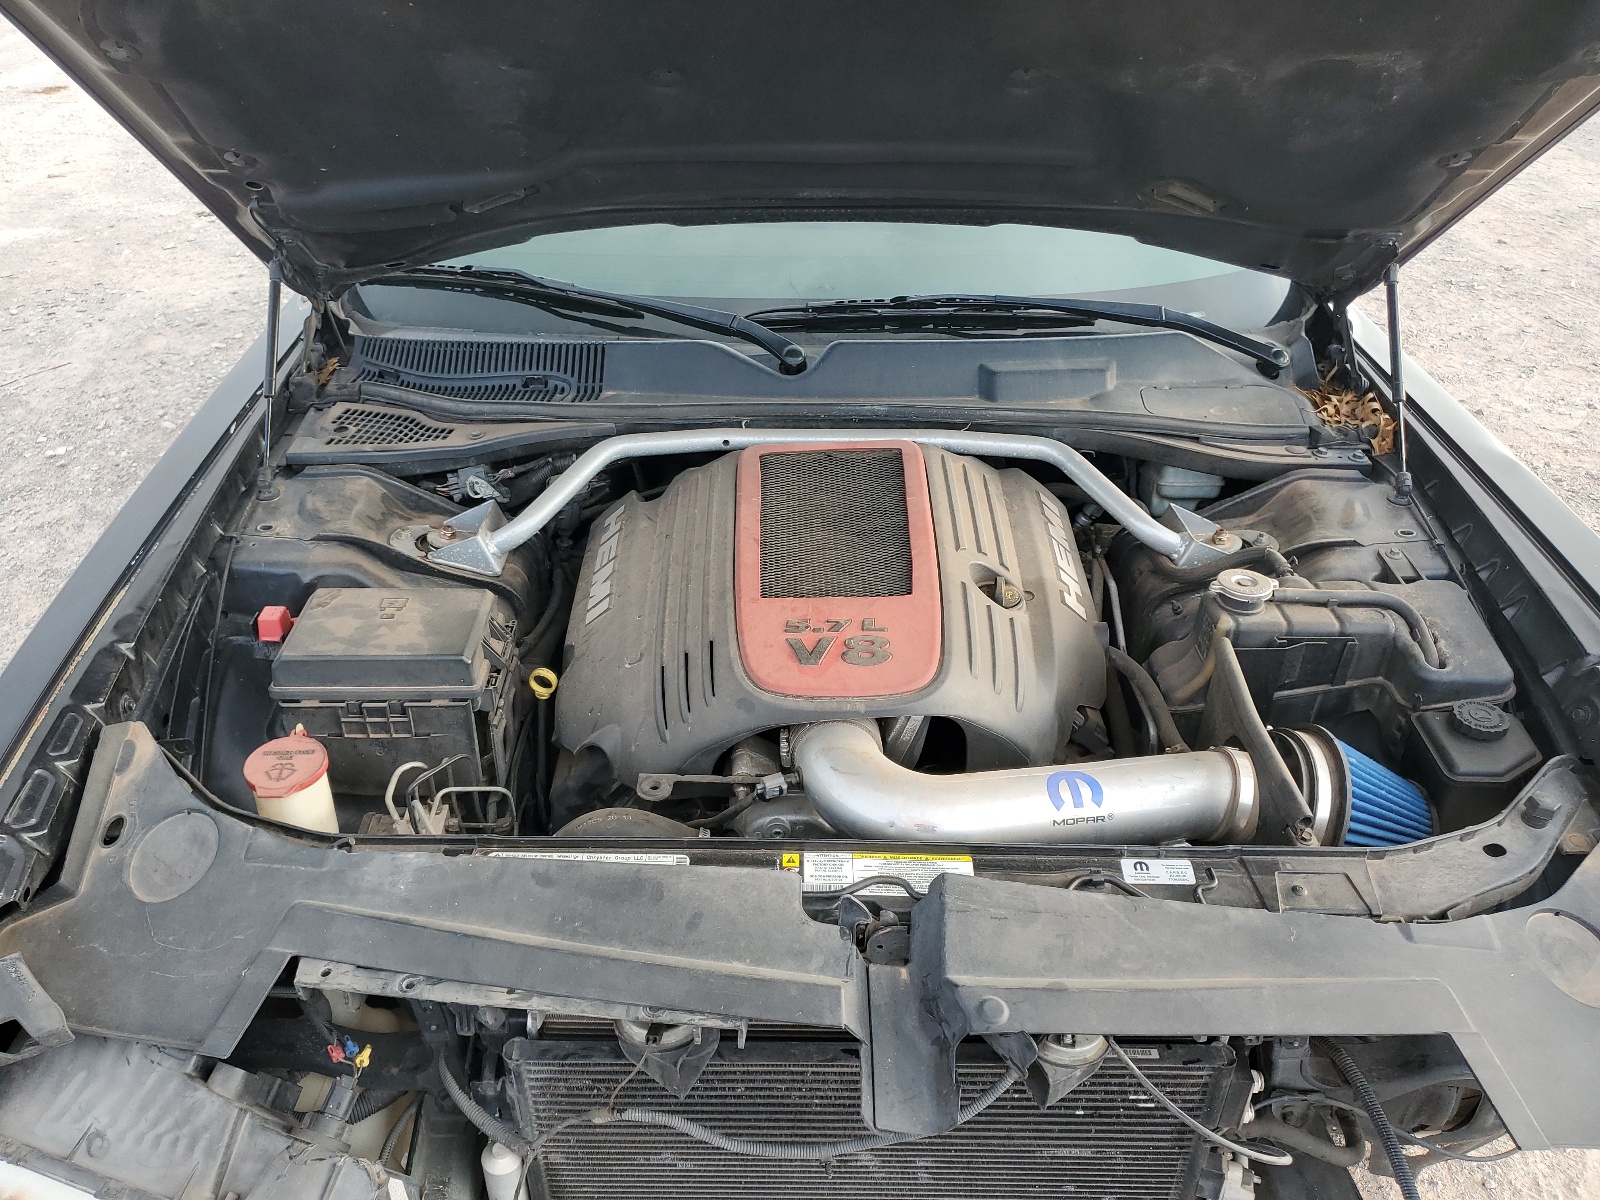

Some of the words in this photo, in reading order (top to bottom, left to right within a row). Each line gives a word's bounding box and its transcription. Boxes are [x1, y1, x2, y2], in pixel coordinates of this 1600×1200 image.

[585, 503, 626, 627] HEMI
[1036, 490, 1087, 622] HEMI
[784, 618, 853, 633] 5.7
[861, 617, 889, 632] L
[784, 634, 894, 667] V8
